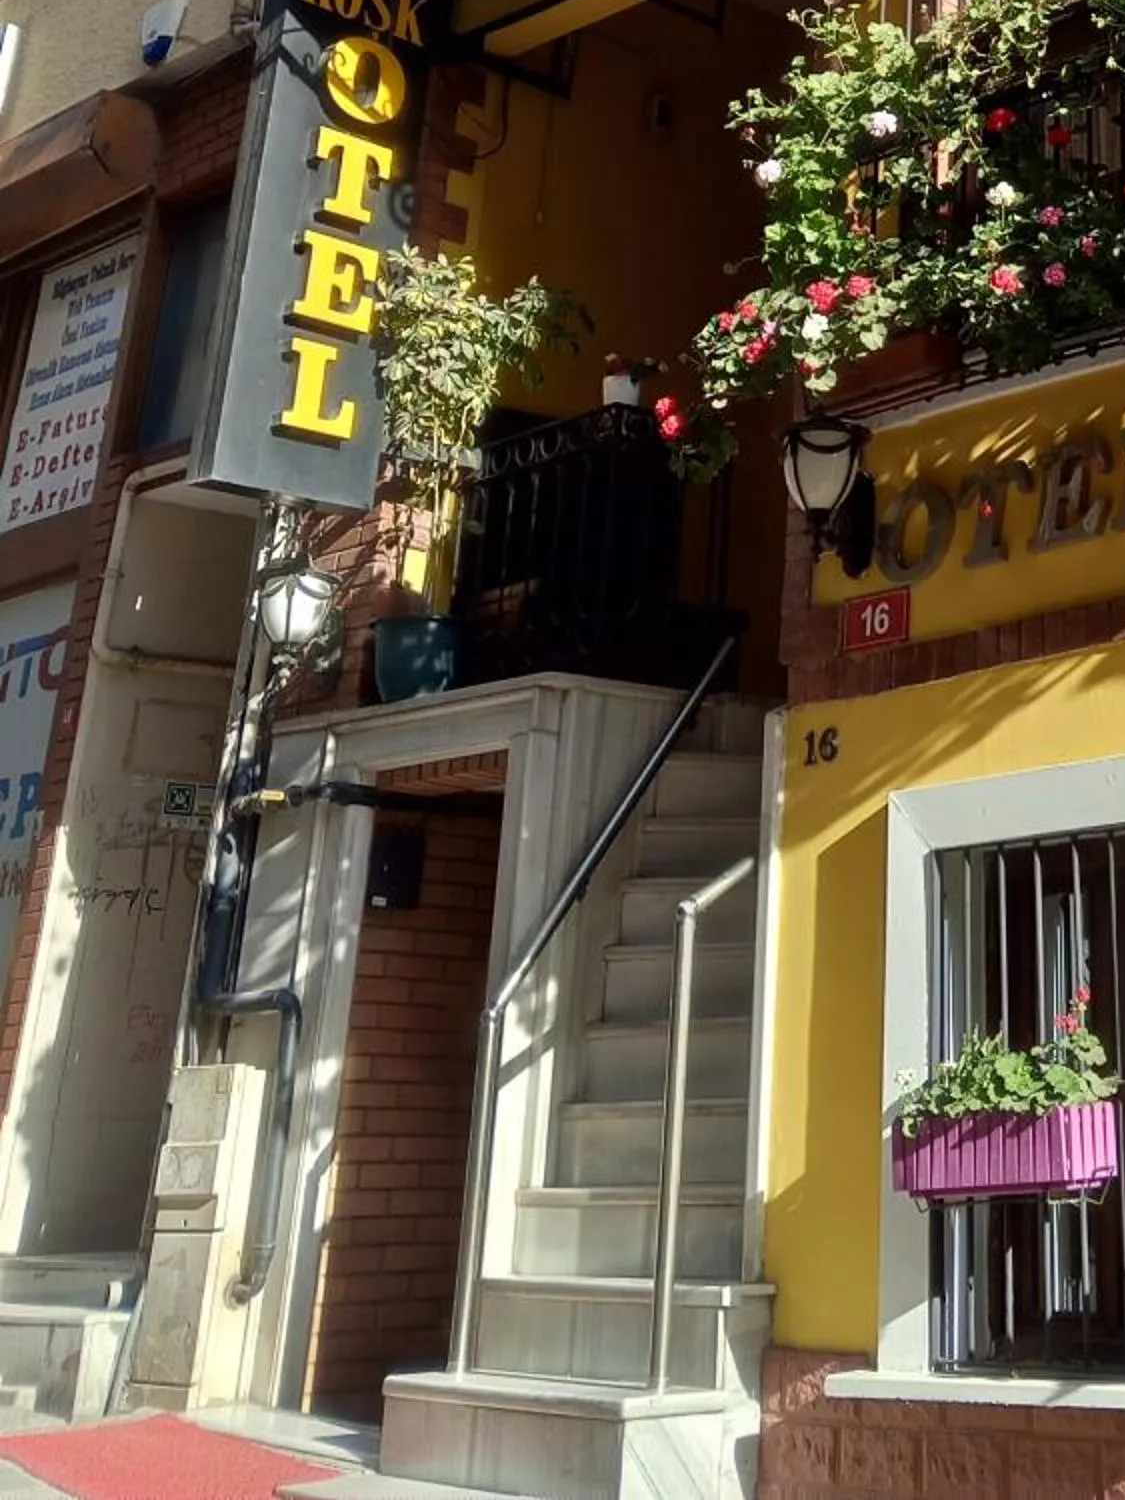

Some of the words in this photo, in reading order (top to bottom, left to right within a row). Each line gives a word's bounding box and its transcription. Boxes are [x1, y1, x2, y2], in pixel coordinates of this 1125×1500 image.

[281, 34, 406, 442] OTEL
[859, 602, 891, 637] 16
[802, 726, 840, 765] 16
